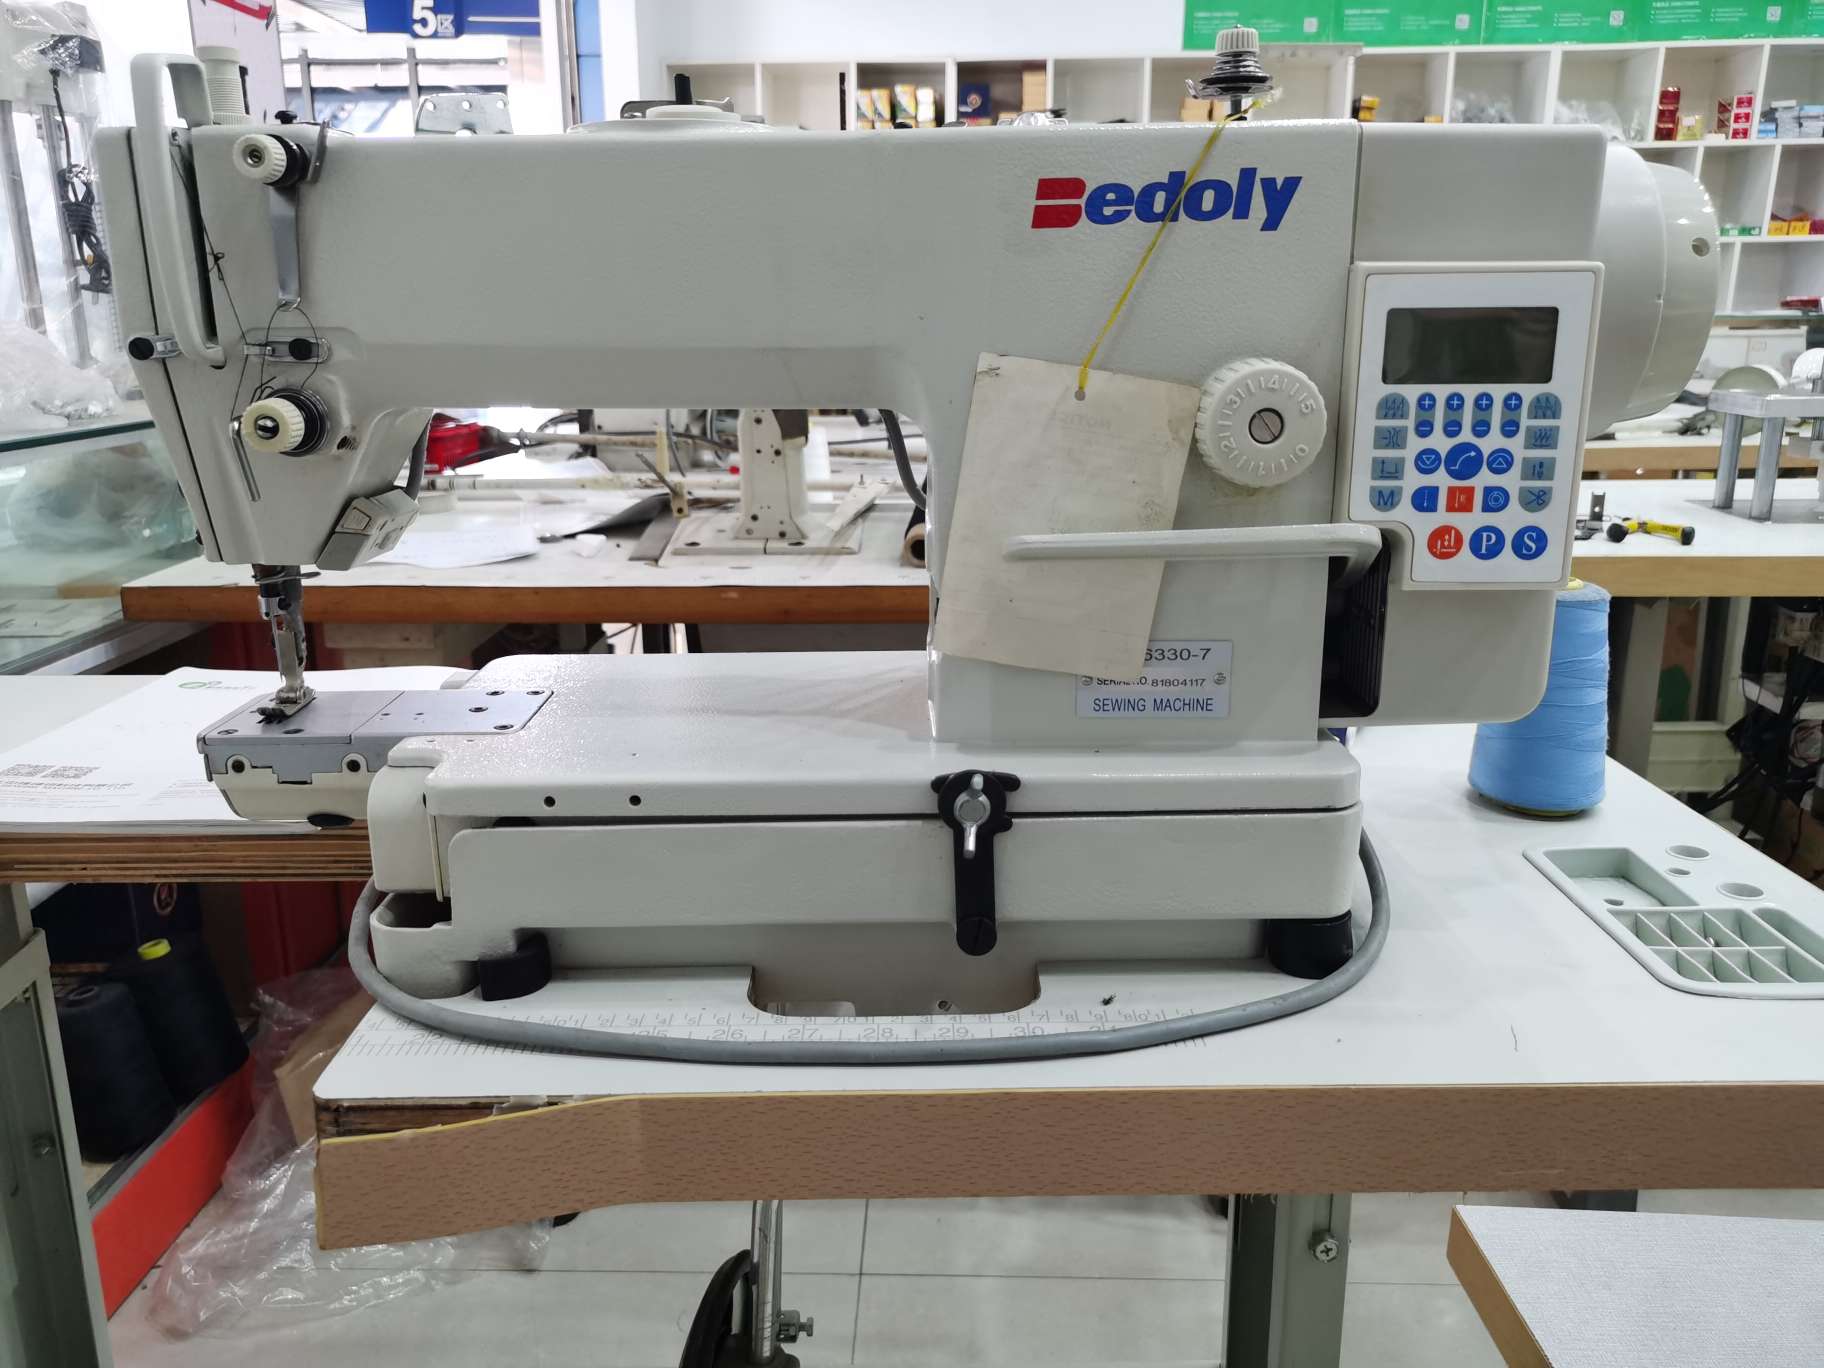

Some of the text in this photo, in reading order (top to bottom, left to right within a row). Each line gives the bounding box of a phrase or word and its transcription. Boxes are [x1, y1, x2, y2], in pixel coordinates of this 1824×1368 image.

[1031, 167, 1303, 232] Bedoly
[1377, 489, 1395, 507] M
[1479, 531, 1537, 555] P S
[1093, 698, 1214, 712] SEWING MACHINE
